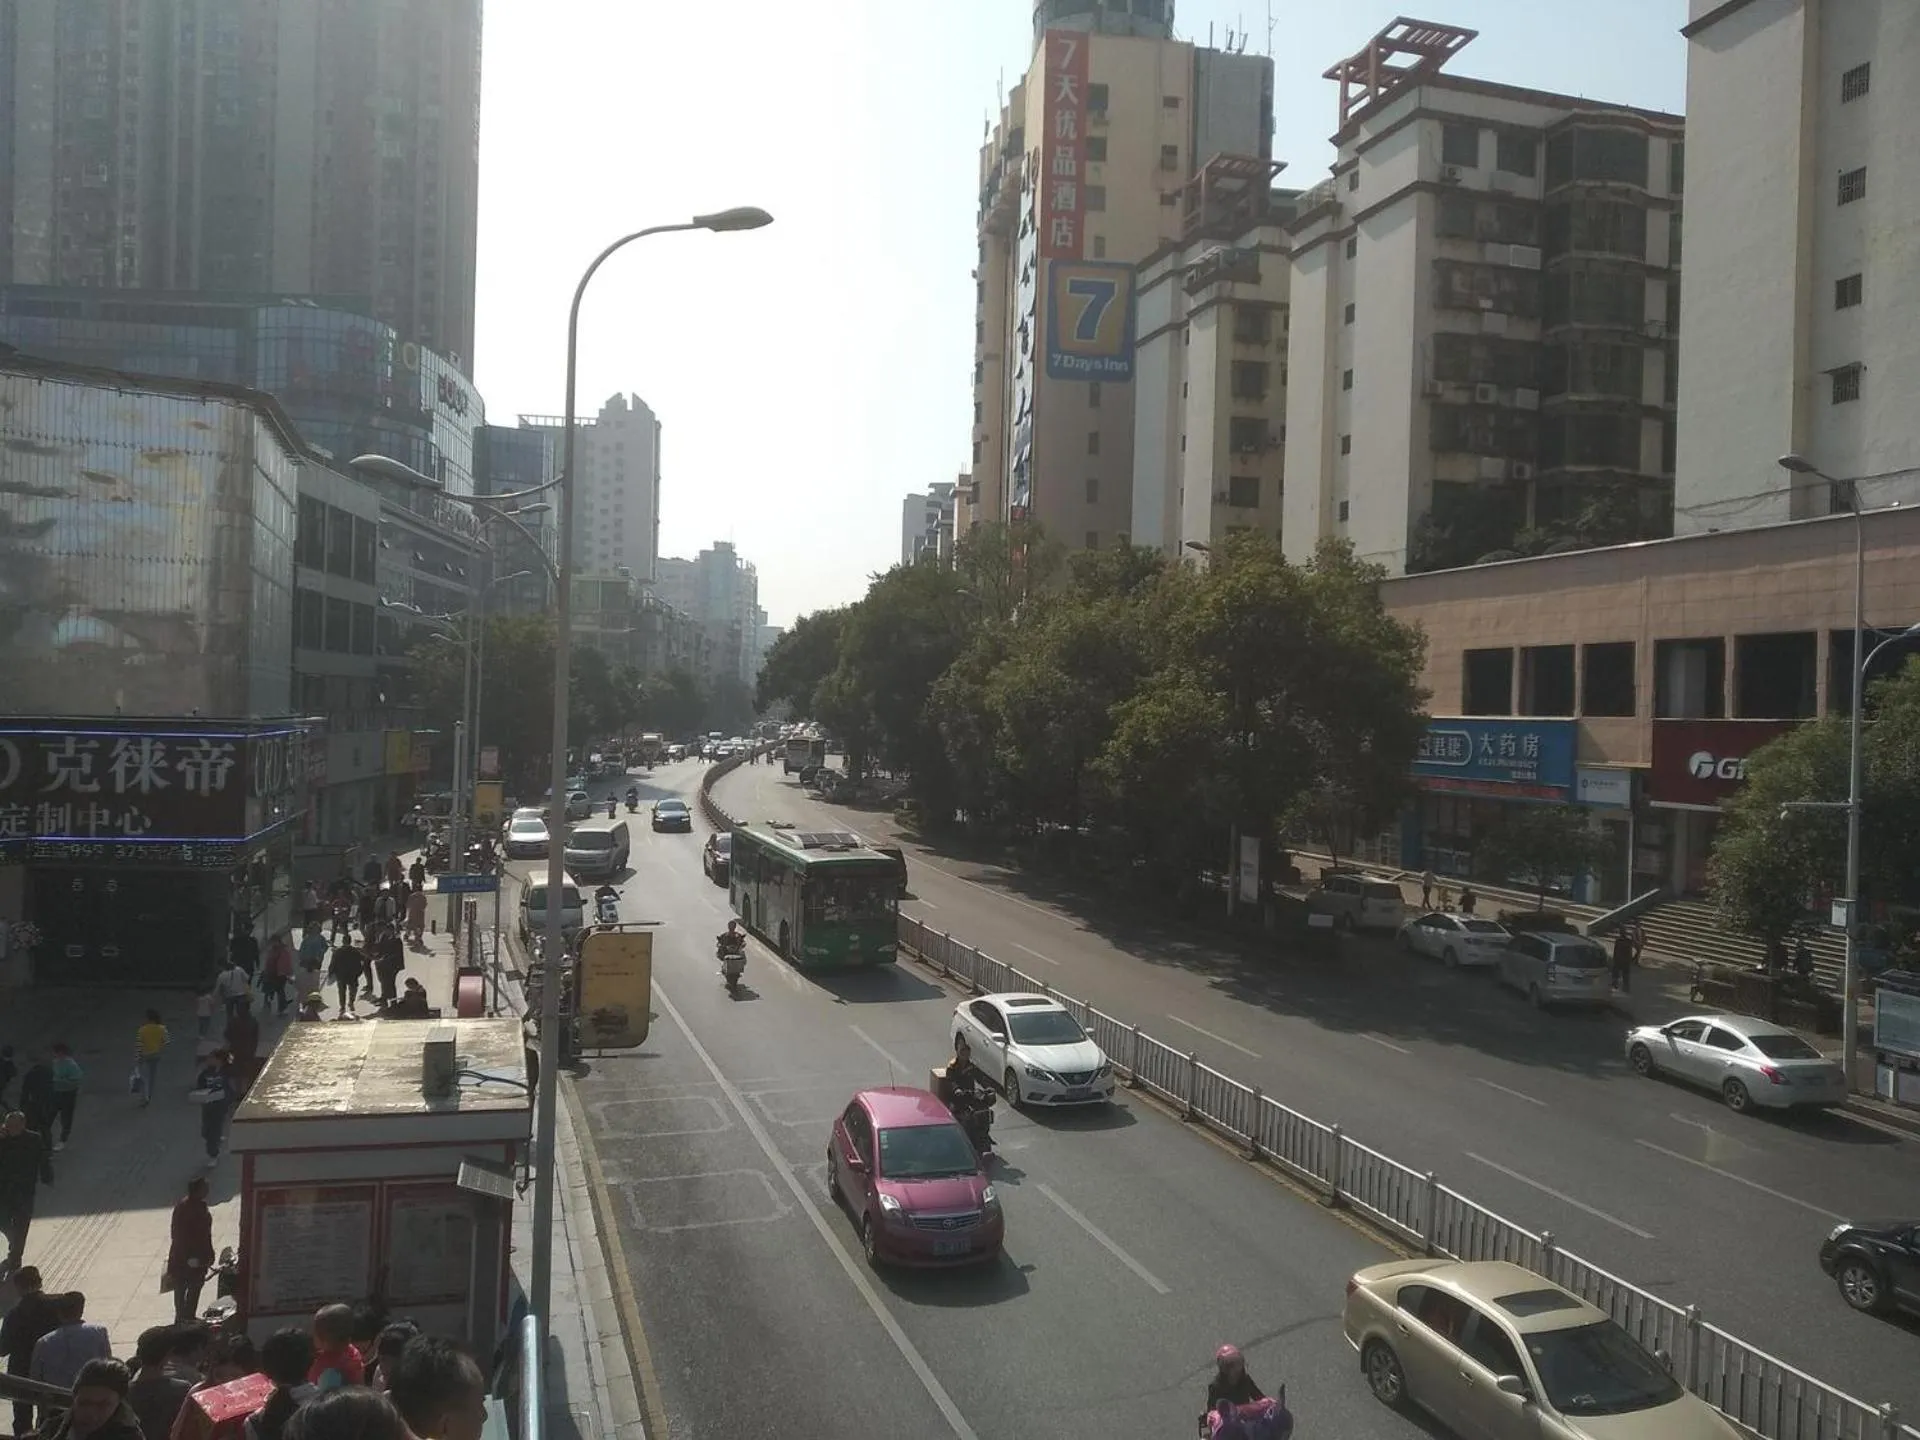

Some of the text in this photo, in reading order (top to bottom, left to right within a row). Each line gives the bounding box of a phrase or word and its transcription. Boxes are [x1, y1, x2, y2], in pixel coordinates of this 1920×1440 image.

[1050, 38, 1079, 248] 7天优品酒店
[1066, 277, 1117, 342] 7
[38, 736, 236, 796] 克徕帝
[1480, 732, 1540, 757] 大药房
[0, 802, 151, 837] 定制中心
